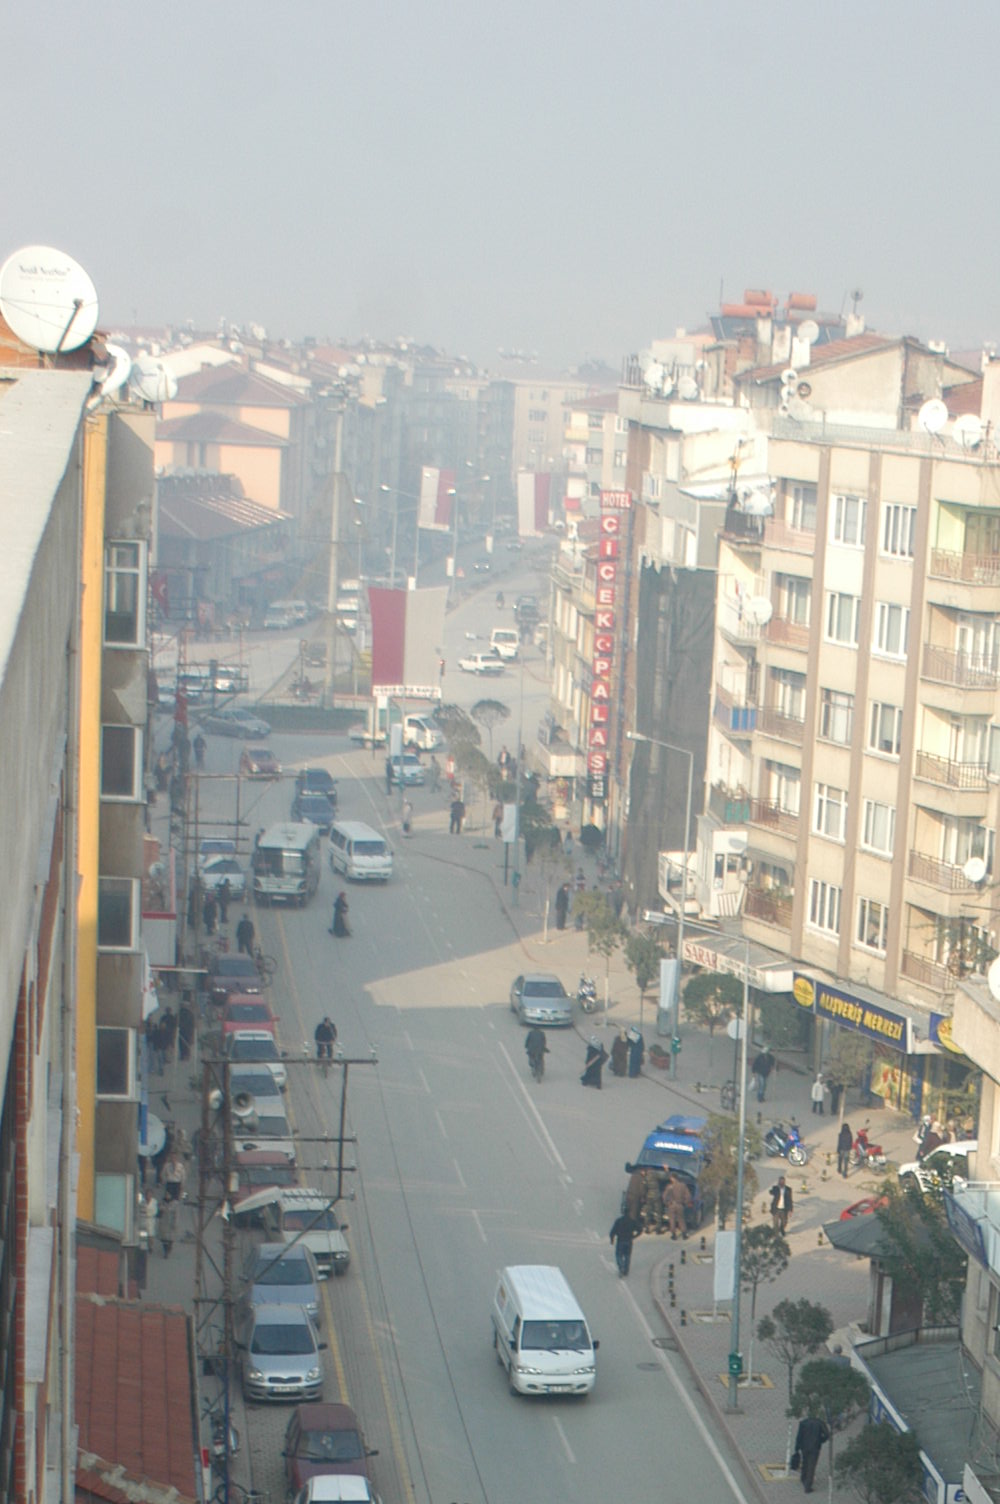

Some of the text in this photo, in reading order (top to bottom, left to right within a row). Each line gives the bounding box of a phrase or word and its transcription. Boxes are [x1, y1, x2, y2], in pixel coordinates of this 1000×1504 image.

[601, 491, 631, 508] HOTEL
[590, 660, 609, 769] PALAS
[818, 990, 864, 1027] ALIŞVERİŞ
[863, 1010, 904, 1041] MERKEZİ
